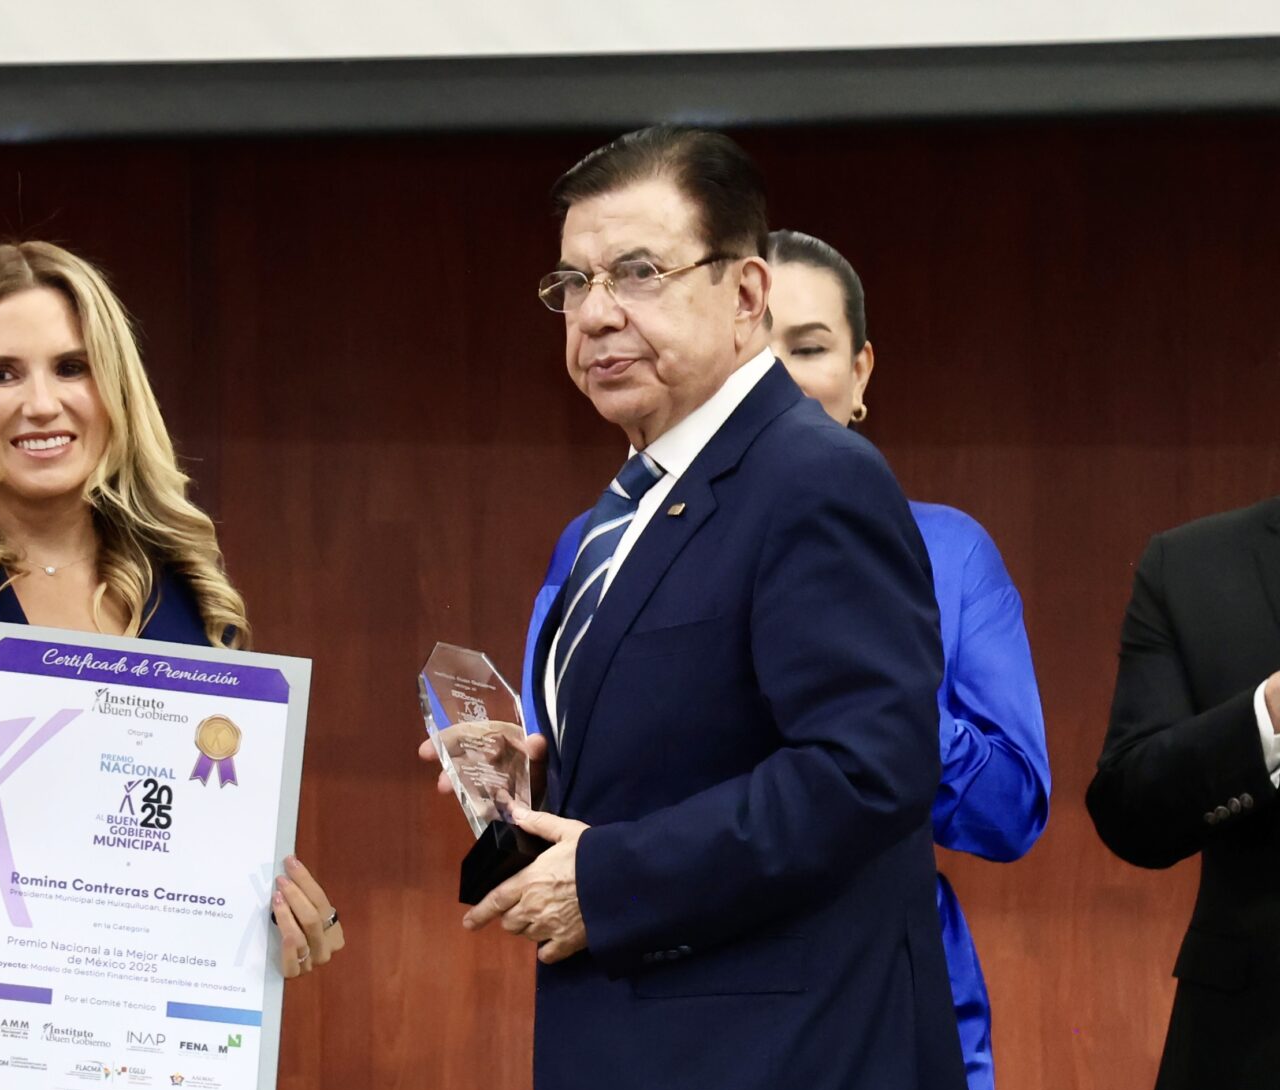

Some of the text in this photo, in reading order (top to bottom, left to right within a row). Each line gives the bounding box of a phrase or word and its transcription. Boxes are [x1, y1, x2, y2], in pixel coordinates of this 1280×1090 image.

[42, 648, 240, 686] Certificado de Premiación
[104, 691, 165, 712] Instituto
[134, 707, 189, 724] Gobierno
[100, 753, 134, 763] PREMIO
[99, 760, 177, 780] NACIONAL
[106, 814, 139, 827] BUEN
[109, 826, 171, 841] GOBIERNO
[93, 834, 170, 853] MUNICIPAL
[10, 871, 226, 906] Romina Contreras Carrasco
[9, 888, 53, 900] Presidenta
[55, 894, 94, 904] Municipal
[95, 898, 105, 906] de
[163, 905, 191, 915] Estado
[192, 908, 202, 916] de
[6, 935, 217, 968] Premio Nacional a la Mejor Alcaldesa
[67, 954, 158, 973] de México 2025
[30, 963, 60, 973] Modelo
[62, 966, 72, 974] de
[74, 968, 106, 978] Gestión
[107, 970, 149, 982] Financiera
[150, 976, 192, 987] Sostenible
[201, 982, 246, 993] Innovadora
[64, 994, 78, 1003] Por
[49, 1025, 94, 1038] Instituto
[126, 1030, 166, 1046] INAP
[71, 1036, 112, 1048] Gobierno
